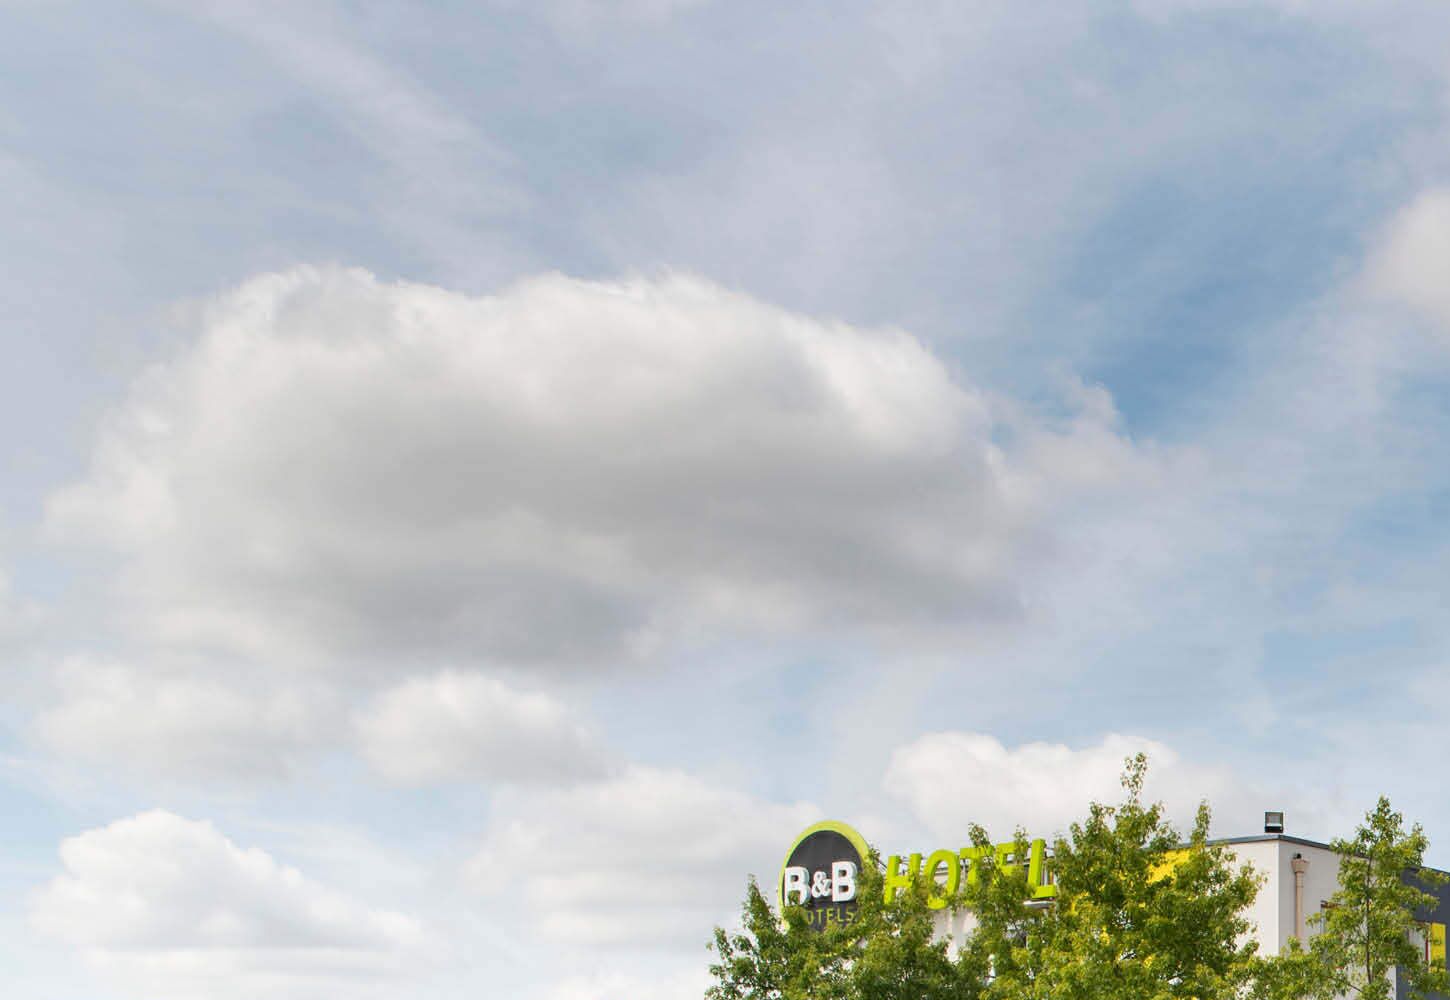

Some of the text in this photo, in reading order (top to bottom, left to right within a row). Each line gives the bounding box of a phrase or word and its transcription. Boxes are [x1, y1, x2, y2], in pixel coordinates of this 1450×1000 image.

[784, 838, 1056, 910] B&B HOTEL
[802, 907, 854, 926] OTELS
